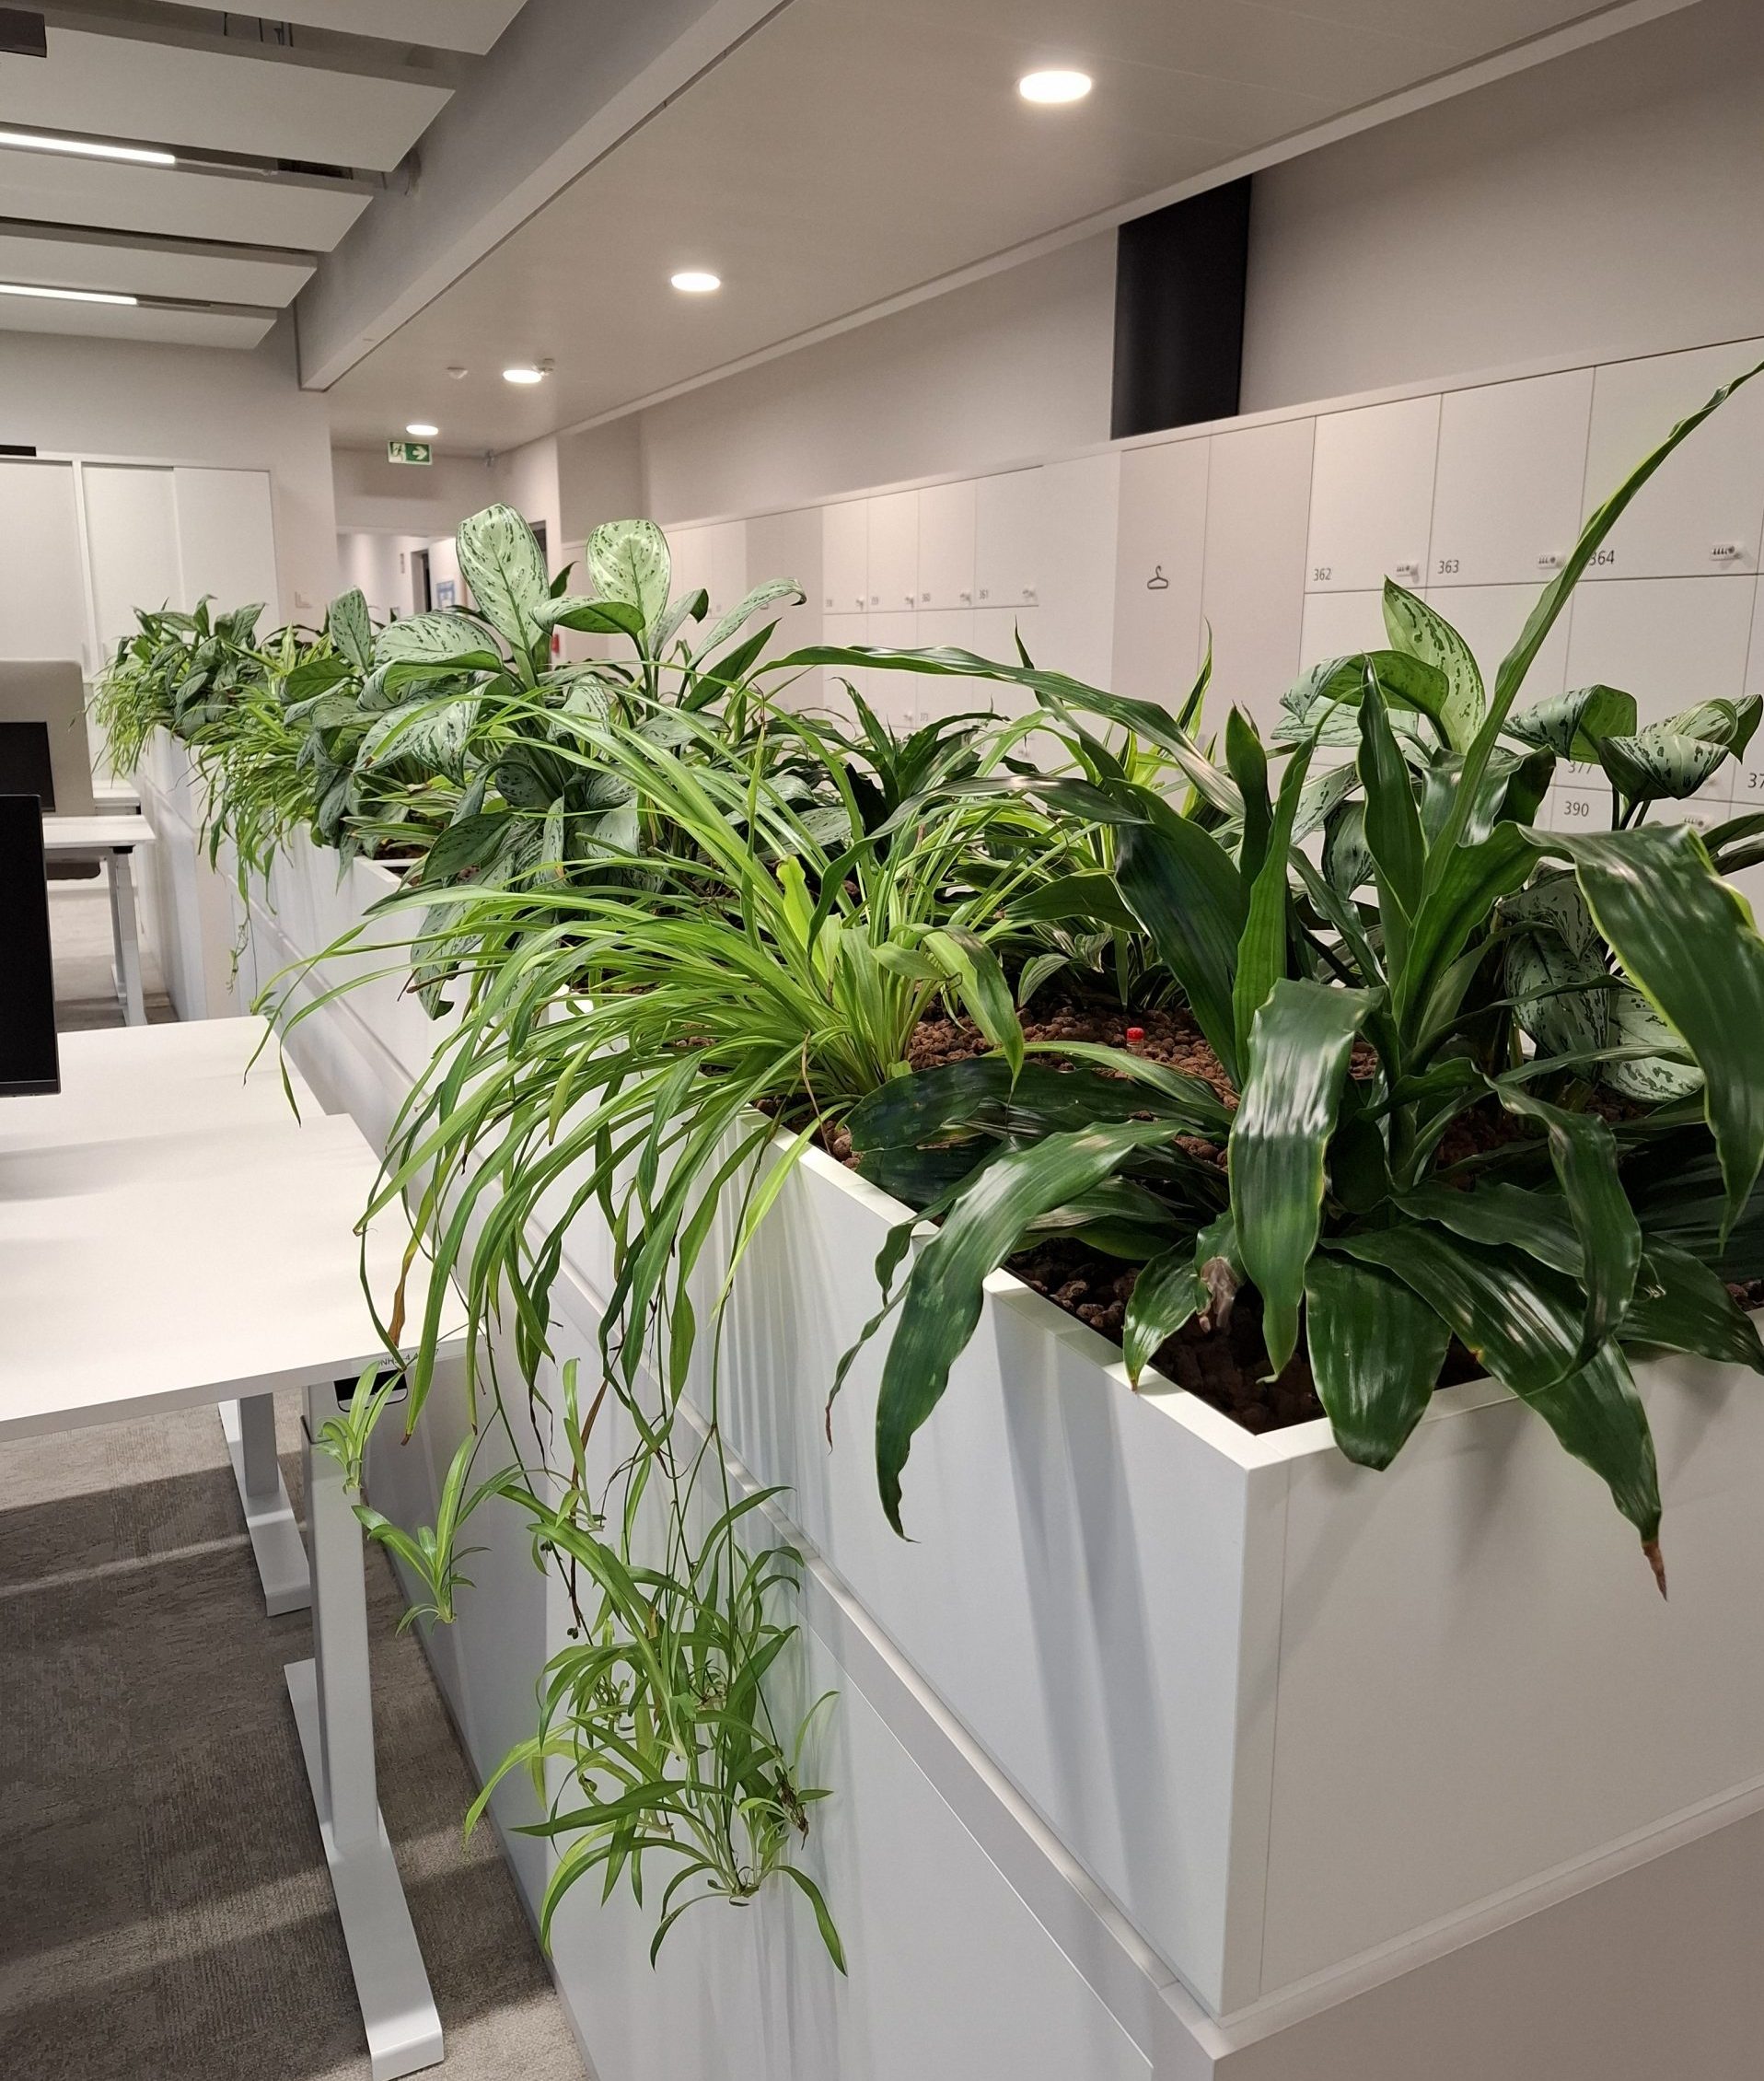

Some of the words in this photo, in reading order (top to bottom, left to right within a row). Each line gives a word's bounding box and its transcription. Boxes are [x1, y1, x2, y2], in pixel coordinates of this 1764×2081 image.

[1589, 550, 1615, 565] 364
[1314, 567, 1332, 581] 362
[1438, 560, 1460, 575] 363
[1563, 800, 1589, 817] 390
